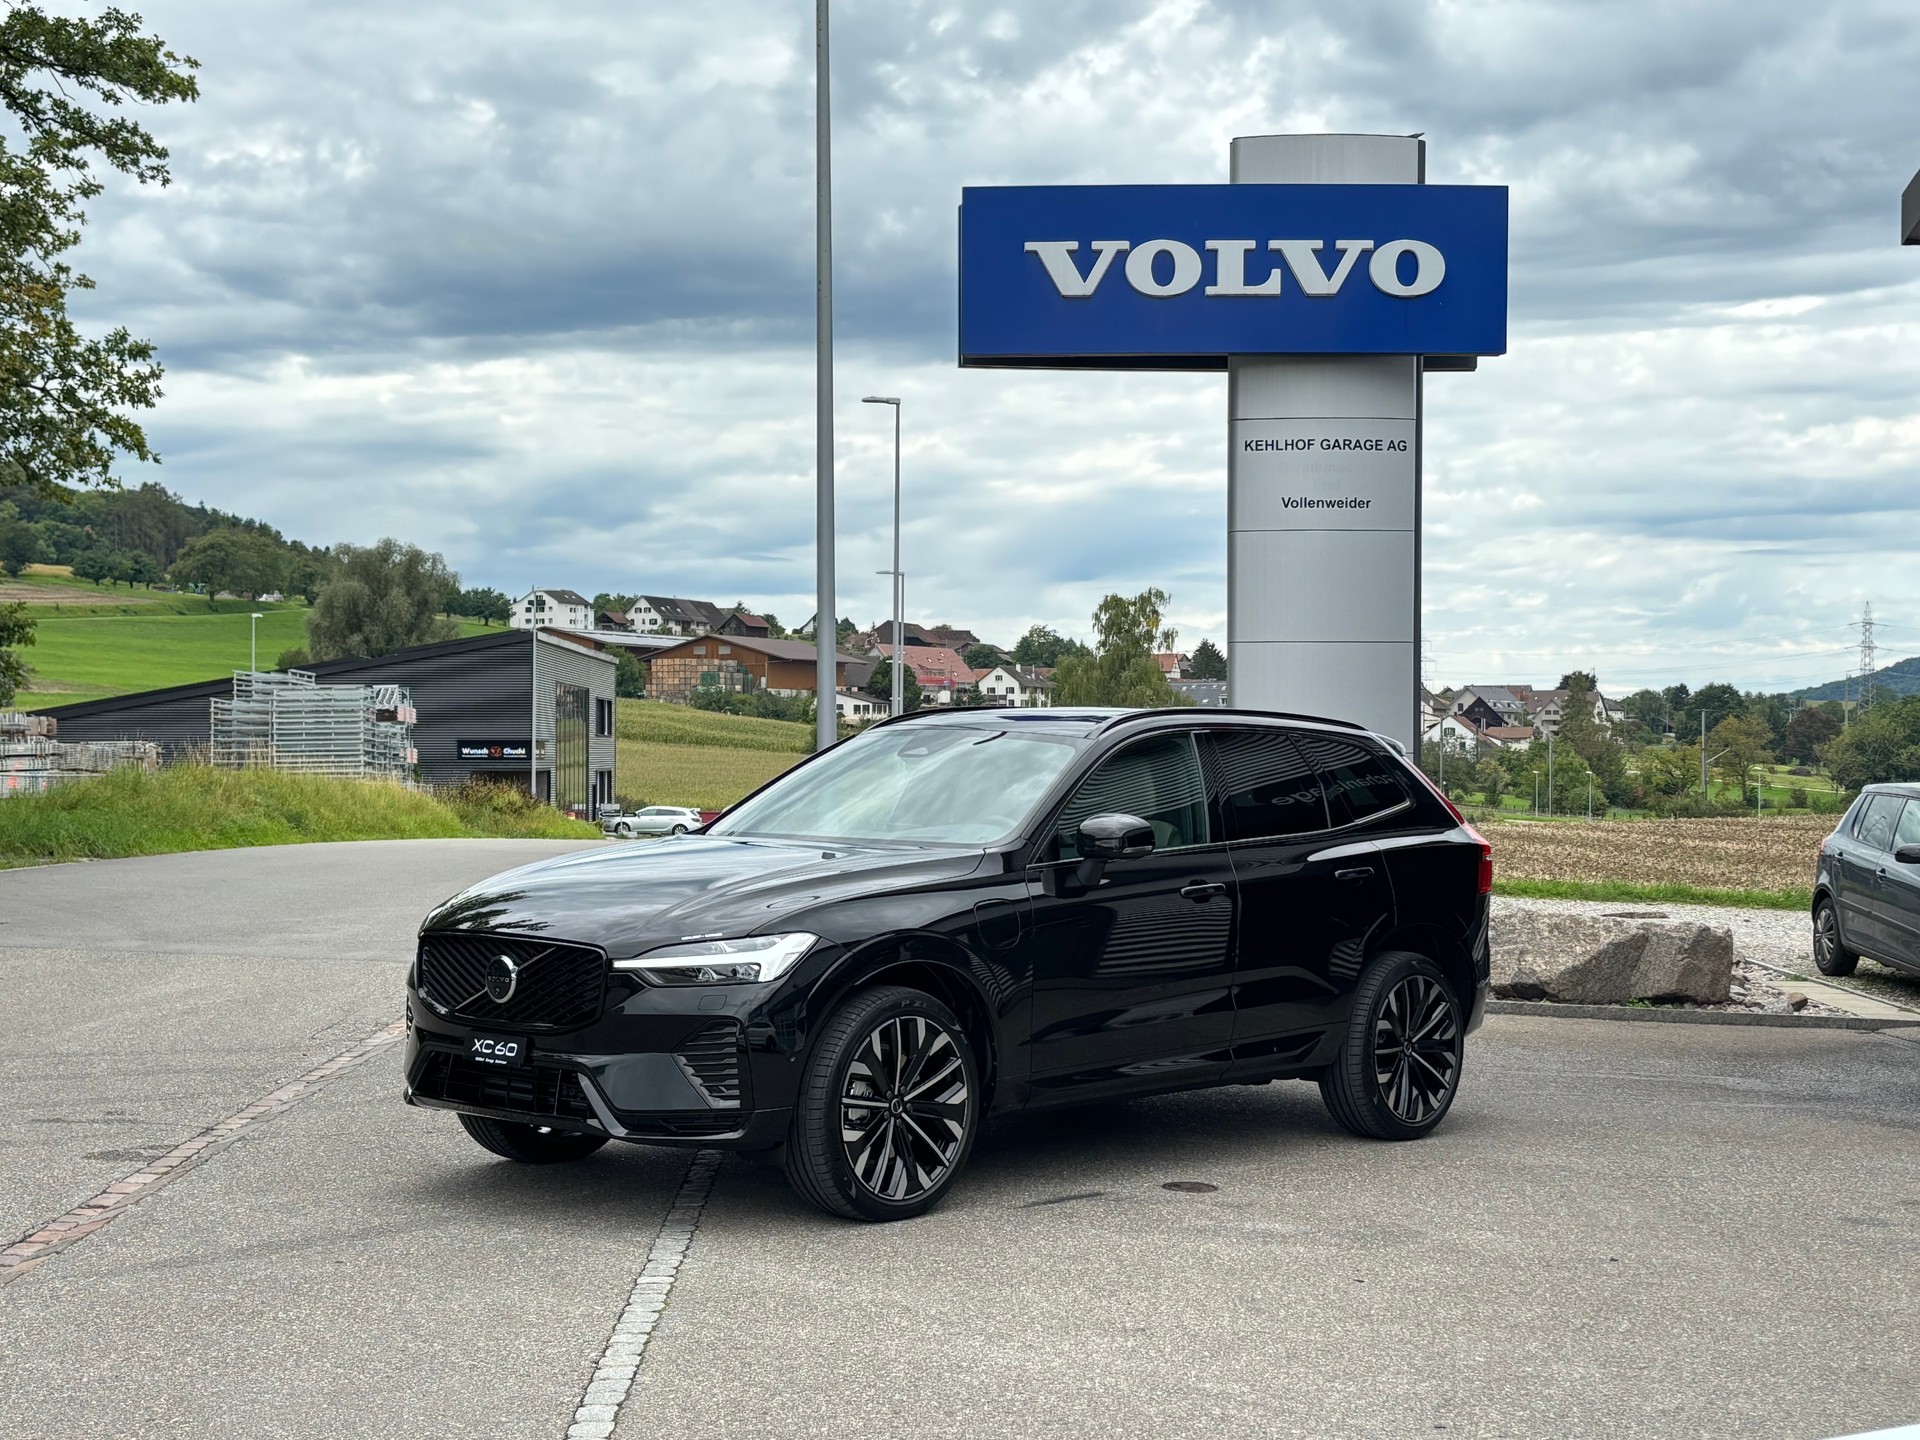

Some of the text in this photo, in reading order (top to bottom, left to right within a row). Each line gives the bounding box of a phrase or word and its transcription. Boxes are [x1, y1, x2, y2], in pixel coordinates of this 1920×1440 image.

[1024, 239, 1446, 298] VOLVO
[1244, 438, 1408, 452] KEHLHOF GARAGE AG
[1281, 496, 1371, 509] Vollenweider
[461, 746, 489, 755] Wunsch
